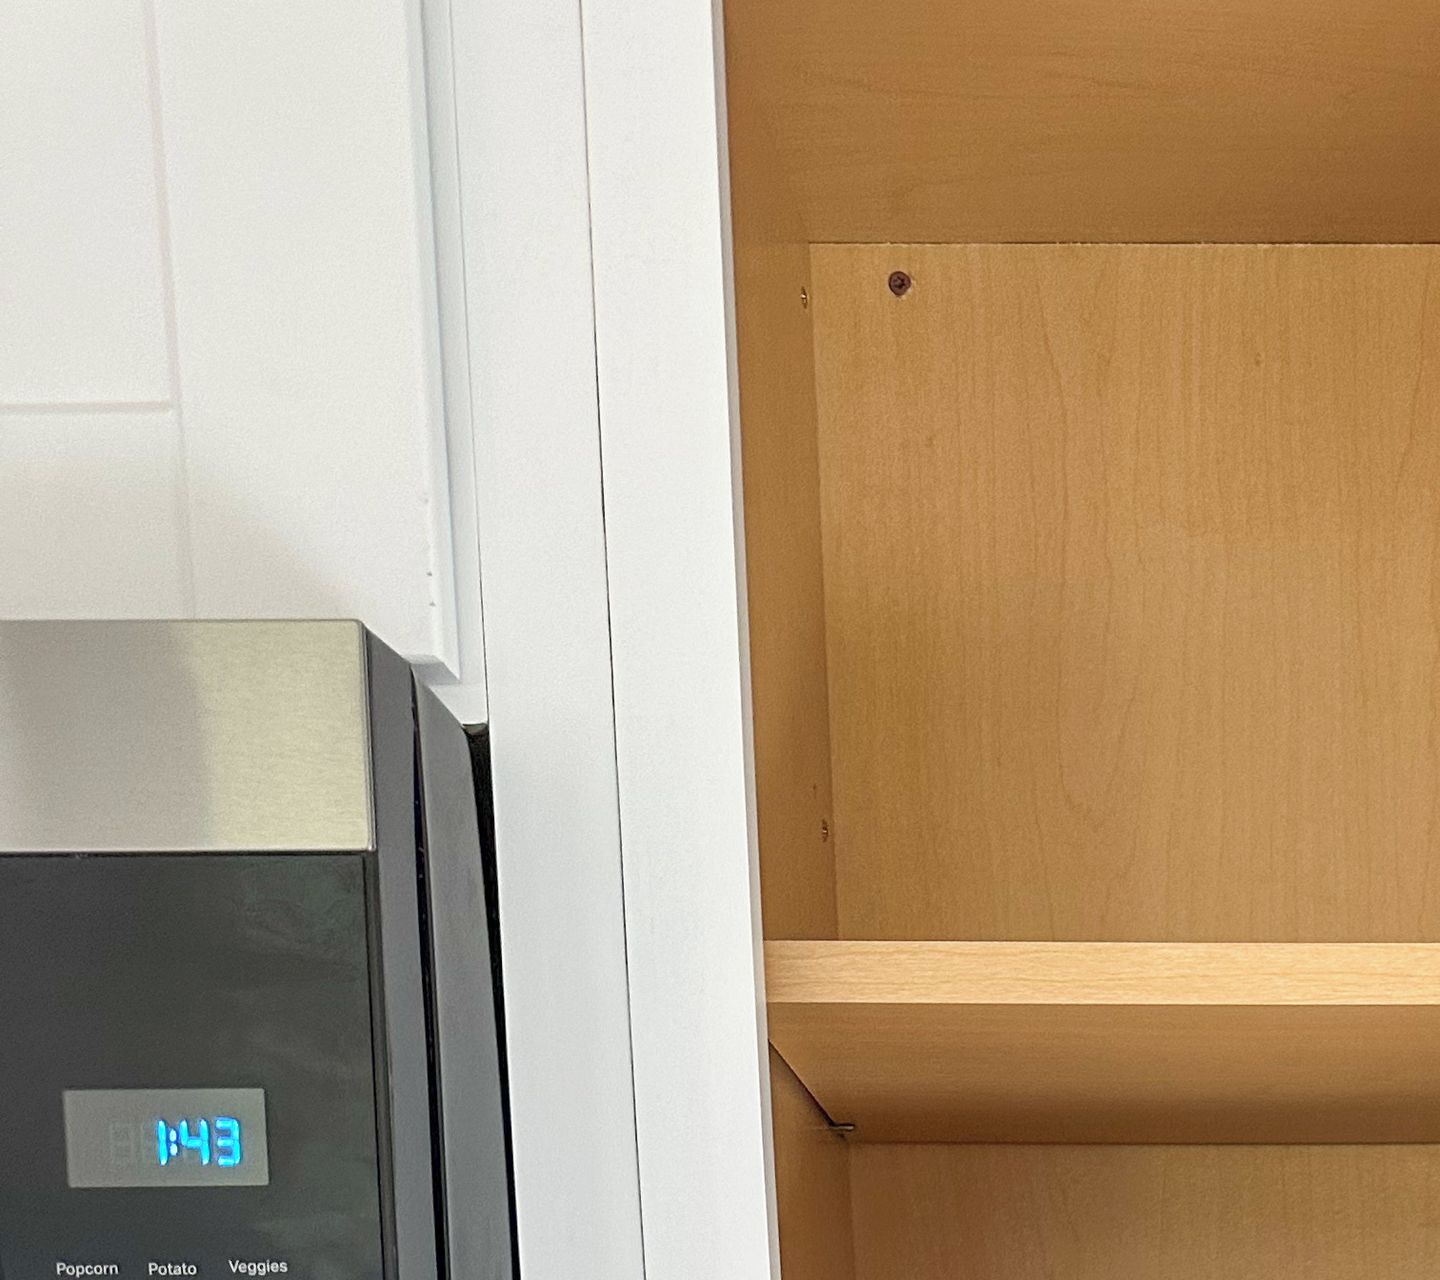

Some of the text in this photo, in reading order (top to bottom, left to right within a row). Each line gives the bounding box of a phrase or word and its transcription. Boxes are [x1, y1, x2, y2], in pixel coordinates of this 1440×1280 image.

[156, 1116, 241, 1167] 1:43
[56, 1262, 119, 1277] Popcorn
[148, 1262, 197, 1276] Potato
[228, 1259, 288, 1275] Veggies
